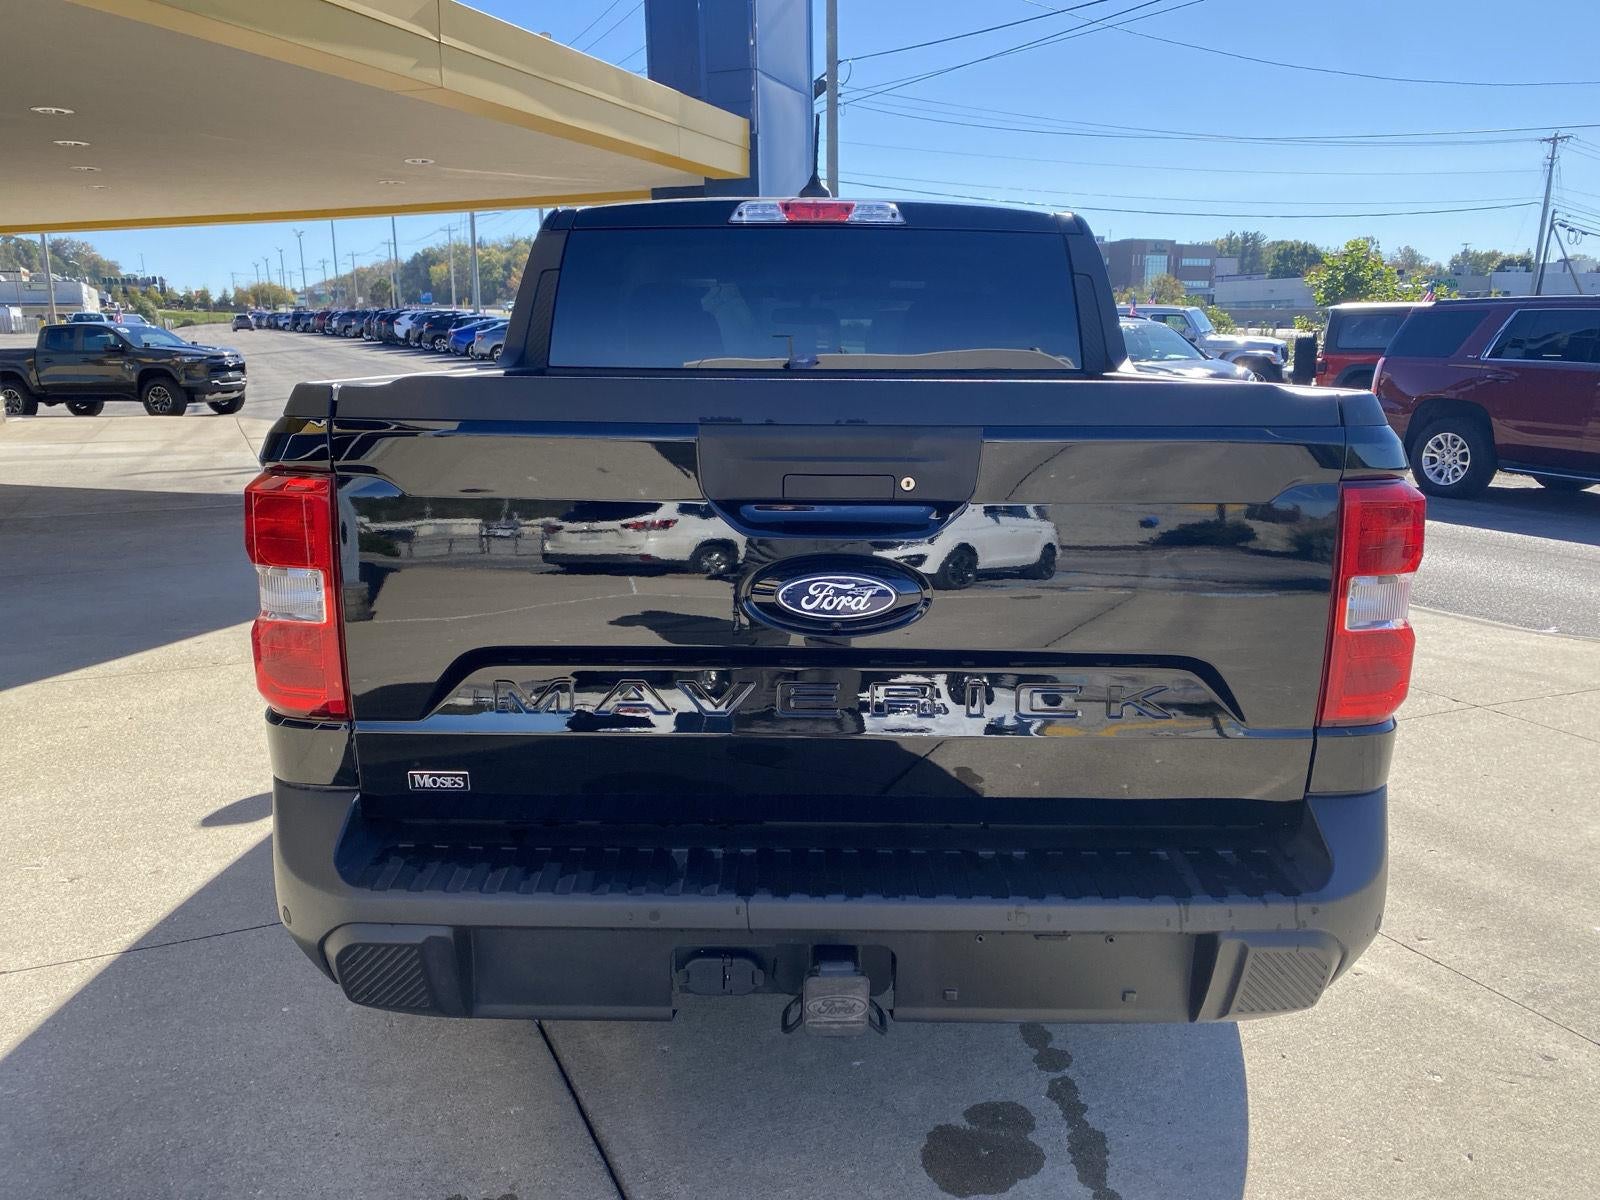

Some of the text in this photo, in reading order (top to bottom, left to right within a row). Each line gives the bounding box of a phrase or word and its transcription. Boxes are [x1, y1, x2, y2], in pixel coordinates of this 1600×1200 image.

[801, 581, 872, 611] Ford
[492, 678, 1172, 719] MAVERICK
[413, 774, 464, 788] MOSES
[817, 999, 857, 1015] Ford
